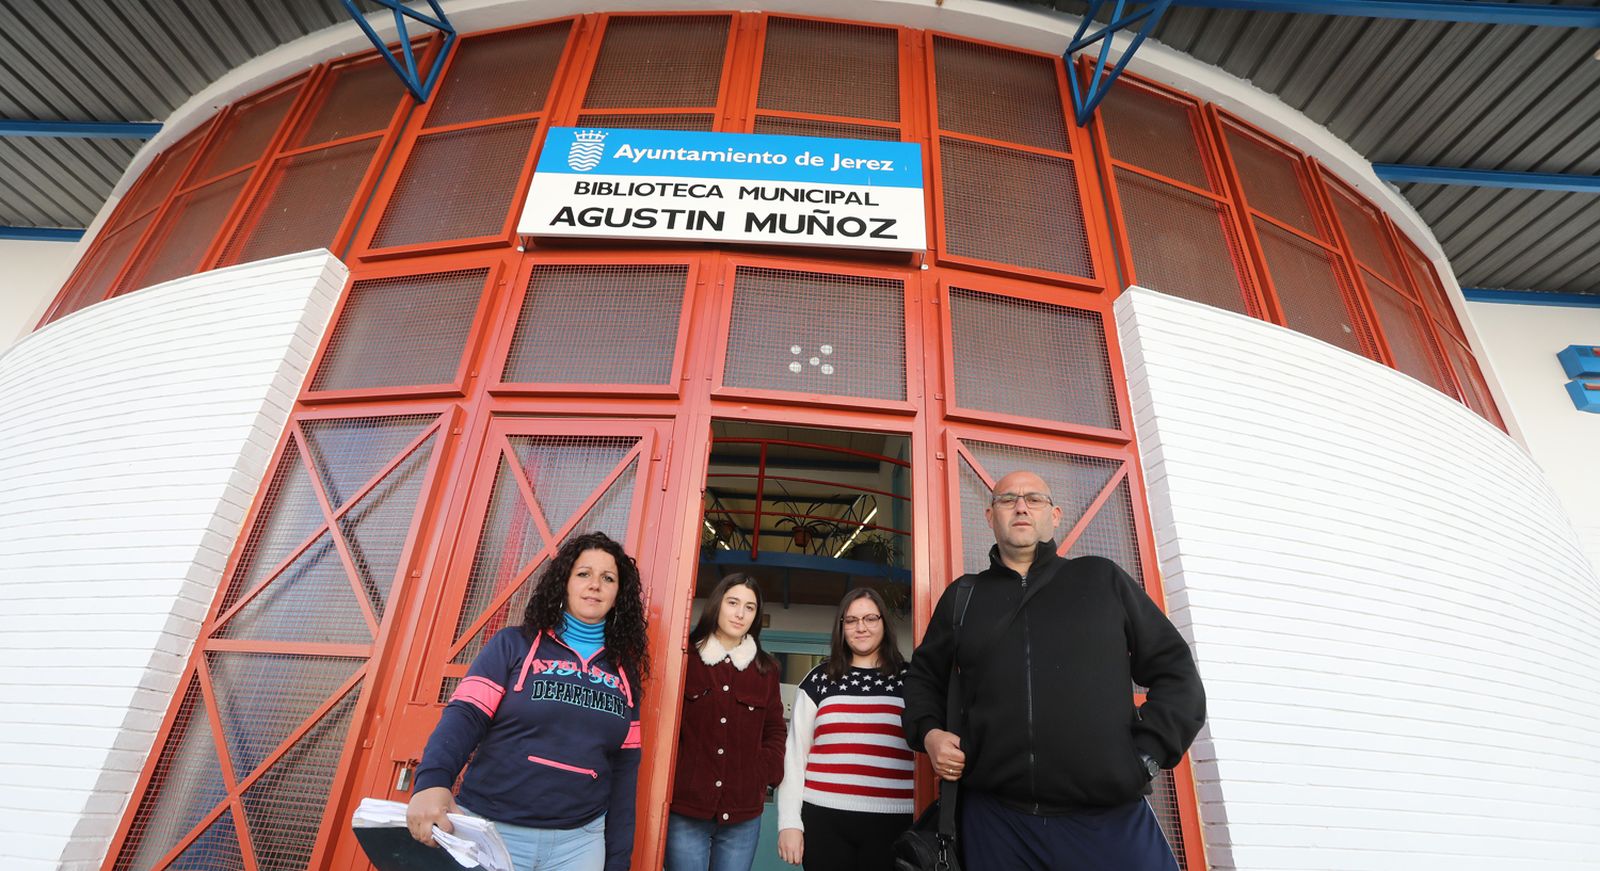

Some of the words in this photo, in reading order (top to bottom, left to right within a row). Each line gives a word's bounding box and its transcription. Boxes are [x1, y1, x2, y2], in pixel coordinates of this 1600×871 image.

[613, 143, 788, 165] Ayuntamiento
[794, 151, 825, 167] de
[831, 153, 895, 172] Jerez
[574, 181, 724, 198] BIBLIOTECA
[738, 186, 880, 206] MUNICIPAL
[549, 206, 725, 231] AGUSTIN
[744, 209, 899, 239] MUÑOZ
